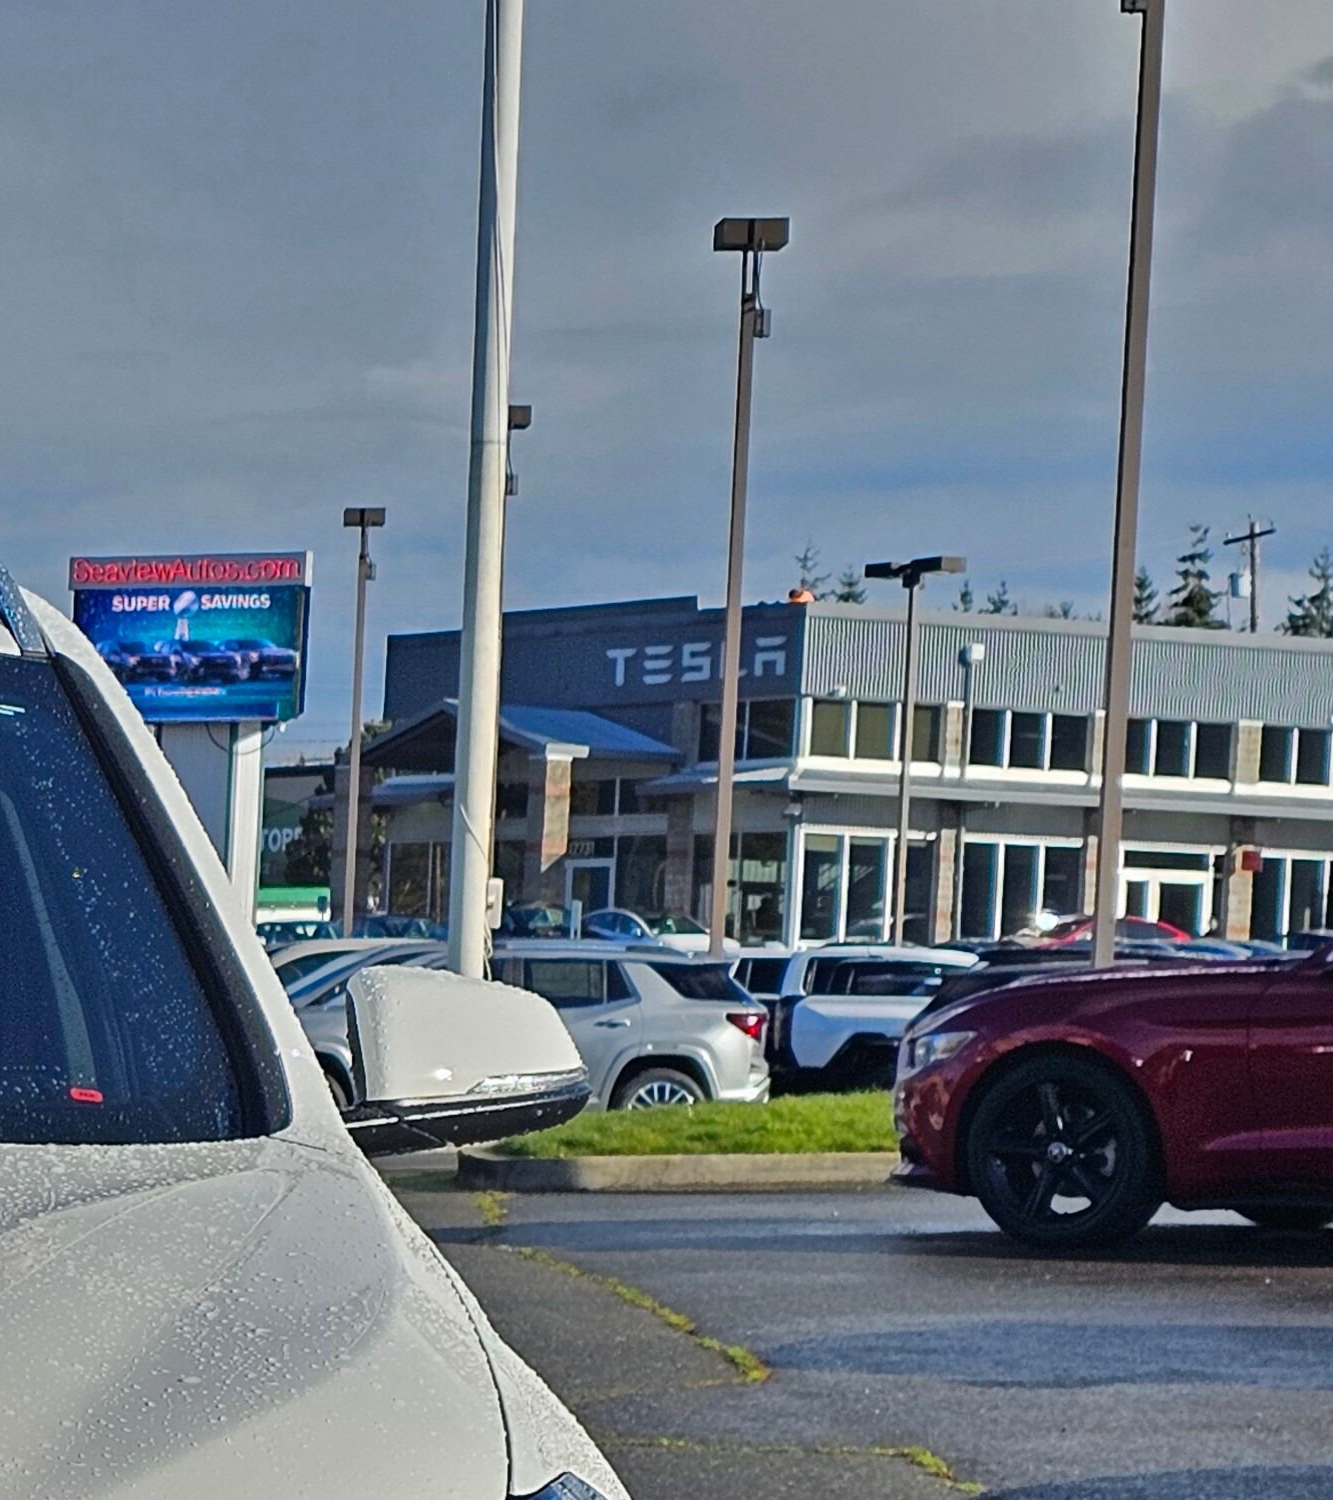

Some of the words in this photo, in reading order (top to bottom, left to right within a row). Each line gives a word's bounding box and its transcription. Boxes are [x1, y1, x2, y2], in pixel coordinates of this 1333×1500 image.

[72, 557, 301, 583] SeaviewAutos.com
[111, 594, 171, 612] SUPER
[200, 593, 272, 611] SAVINGS
